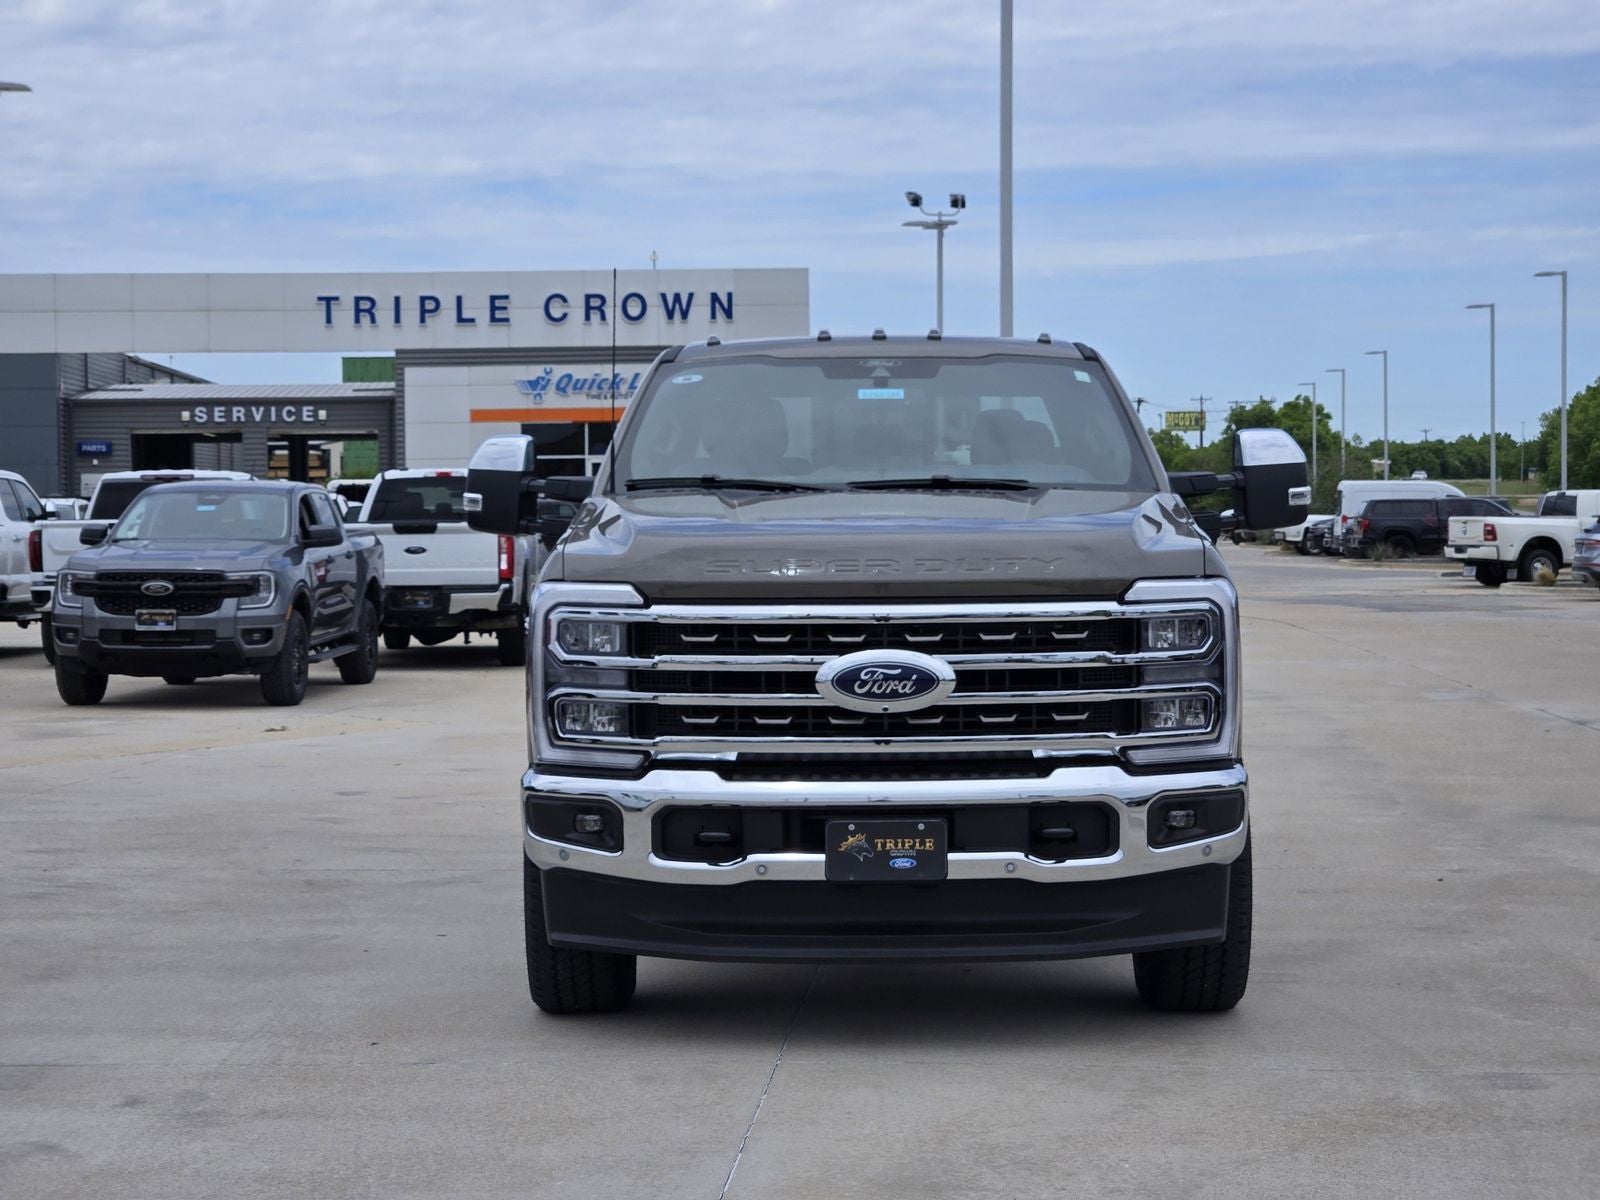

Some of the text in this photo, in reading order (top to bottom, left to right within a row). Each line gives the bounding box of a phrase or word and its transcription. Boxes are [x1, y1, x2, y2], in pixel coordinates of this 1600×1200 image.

[317, 291, 734, 326] TRIPLE CROWN
[555, 372, 624, 394] Quick
[194, 406, 315, 422] SERVICE
[81, 444, 106, 452] PARTS
[704, 557, 1063, 575] SUPER DUTY
[854, 667, 918, 694] Ford
[874, 838, 935, 851] TRIPLE
[894, 859, 912, 868] Ford
